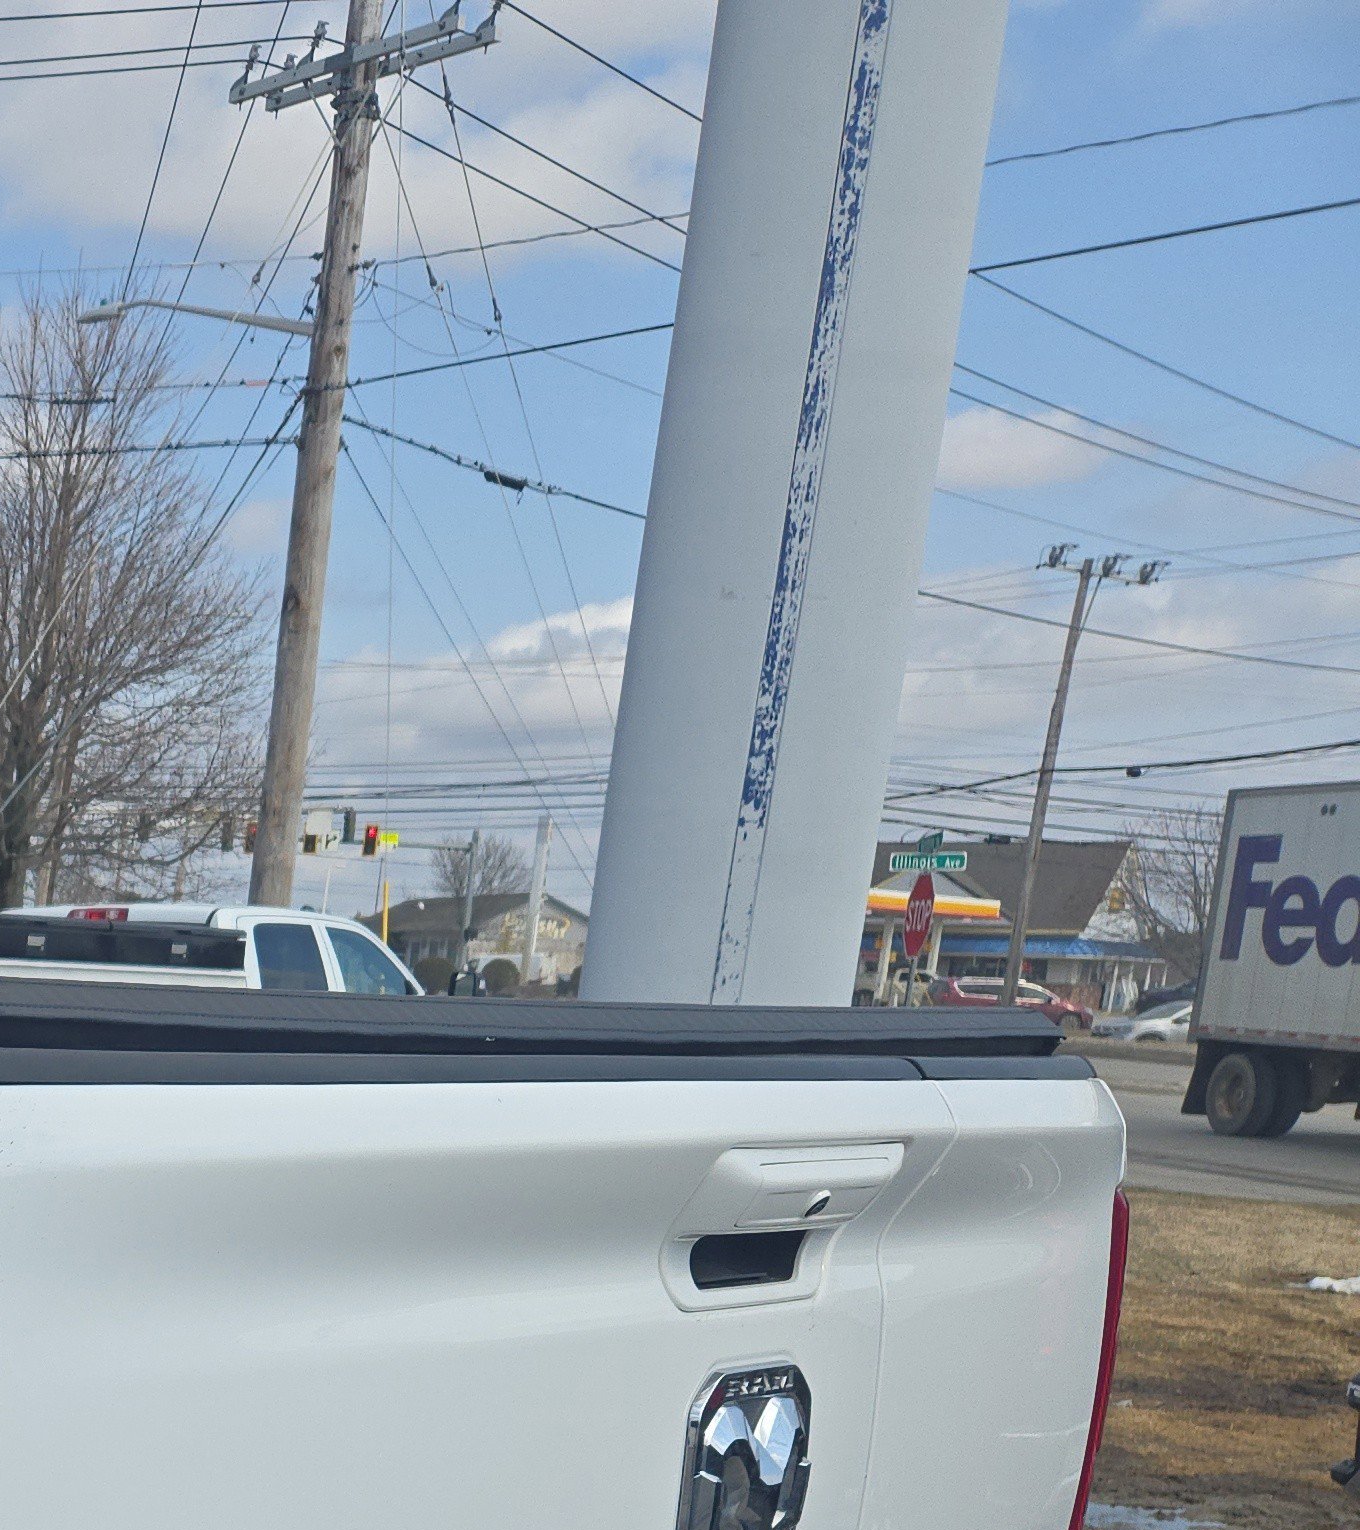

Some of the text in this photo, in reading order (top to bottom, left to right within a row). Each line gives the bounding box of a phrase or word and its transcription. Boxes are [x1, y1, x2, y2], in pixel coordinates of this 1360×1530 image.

[895, 854, 961, 870] Illinois Ave
[905, 898, 932, 933] STOP
